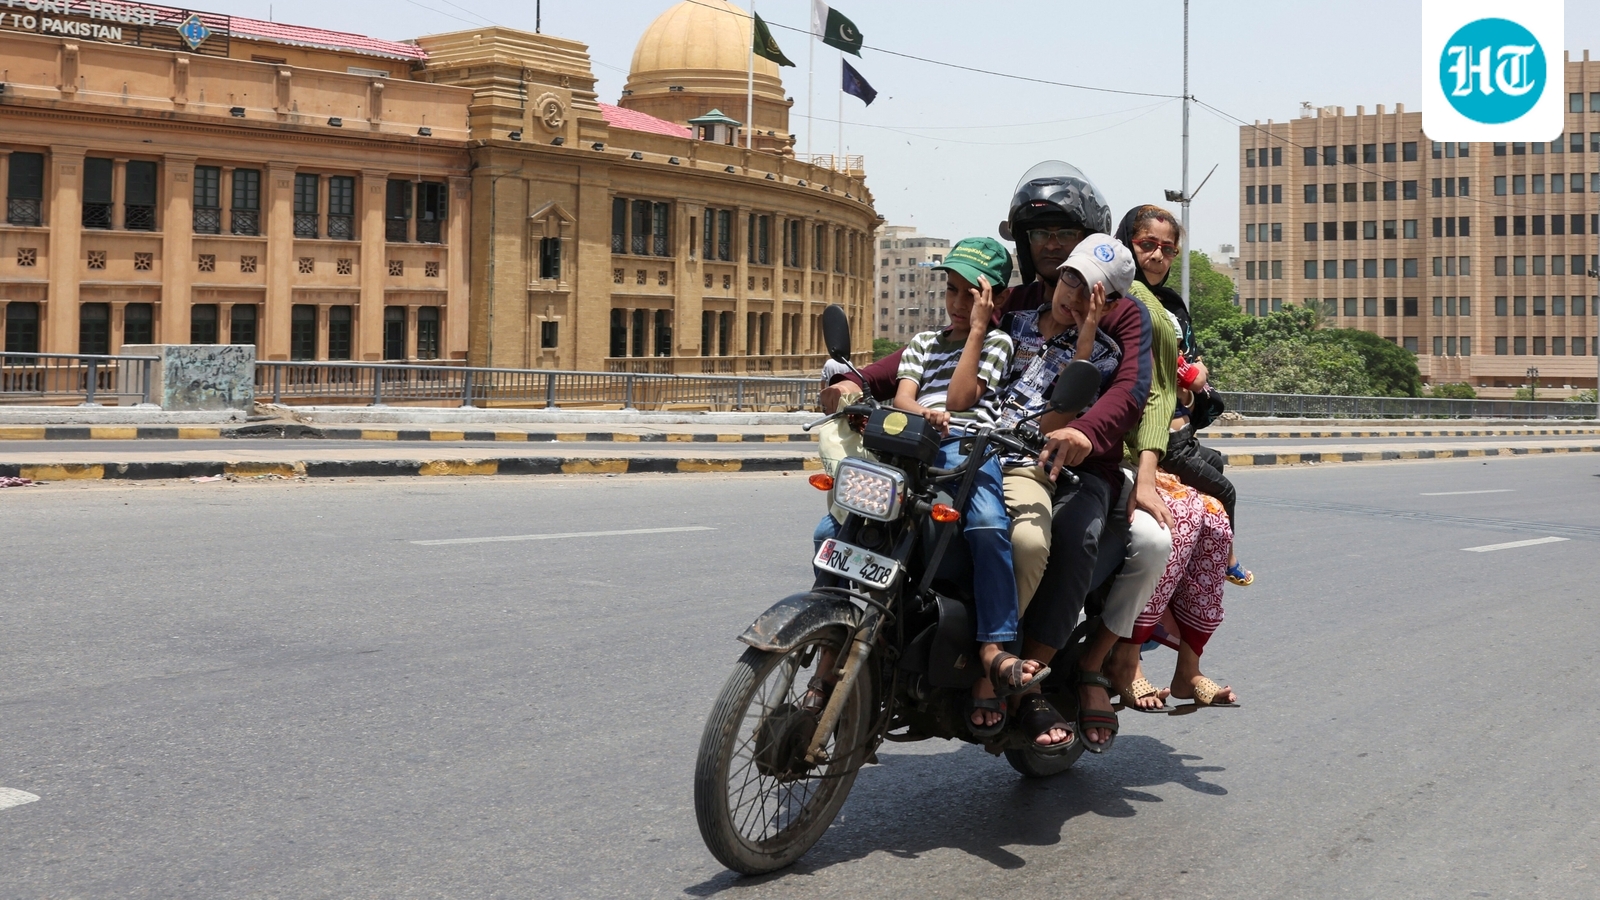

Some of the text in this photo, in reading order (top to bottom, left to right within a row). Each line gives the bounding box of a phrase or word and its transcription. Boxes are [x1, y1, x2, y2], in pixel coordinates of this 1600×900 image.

[86, 1, 159, 26] TRUST
[11, 14, 37, 29] TO
[42, 18, 122, 40] PAKISTAN
[826, 550, 892, 584] RNL 4208
